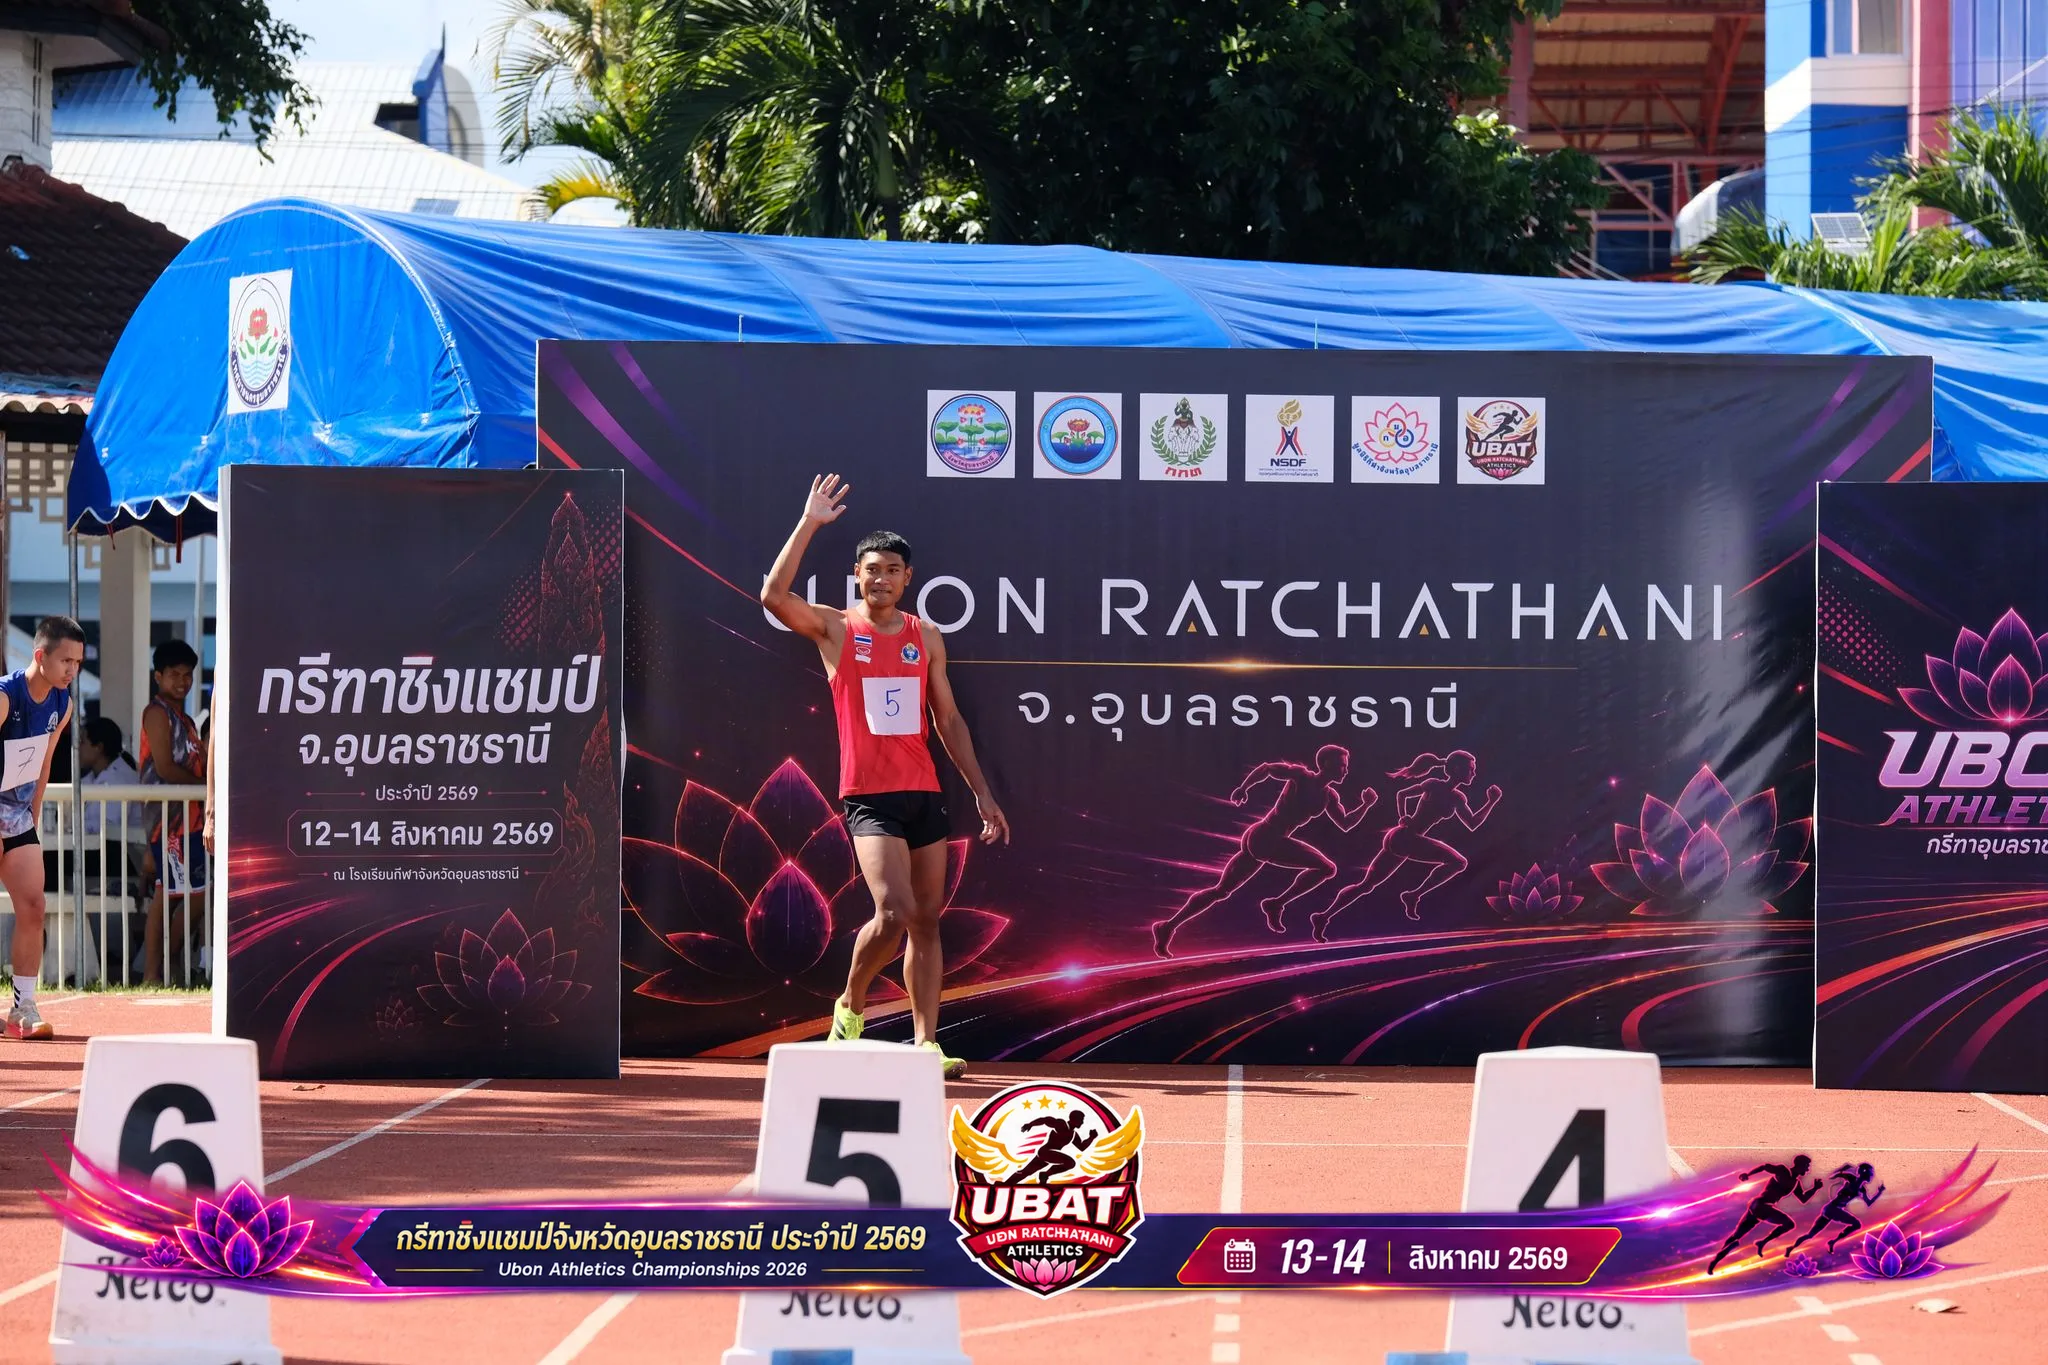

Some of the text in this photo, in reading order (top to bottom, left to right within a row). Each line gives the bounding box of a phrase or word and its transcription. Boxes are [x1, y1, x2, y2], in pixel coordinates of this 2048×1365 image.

[1270, 458, 1306, 467] NSDF
[1472, 441, 1531, 457] UBAT
[1101, 579, 1722, 641] RATCHATHANI
[257, 652, 602, 714] กรีฑาชิงแชมป์
[885, 688, 901, 717] 5
[1018, 682, 1457, 742] จ.อุบลราชธานี
[18, 746, 36, 777] 7
[299, 722, 552, 777] จ.อุบลราชธานี
[375, 784, 479, 802] ประจำปี 2569
[391, 820, 483, 846] สิงหาคม
[492, 822, 554, 846] 2569
[333, 866, 520, 884] ณ โรงเรียนกีฬาจังหวัดอุบลราชธานี
[118, 1083, 217, 1201] 6
[806, 1097, 900, 1209] 5
[1518, 1109, 1605, 1213] 4
